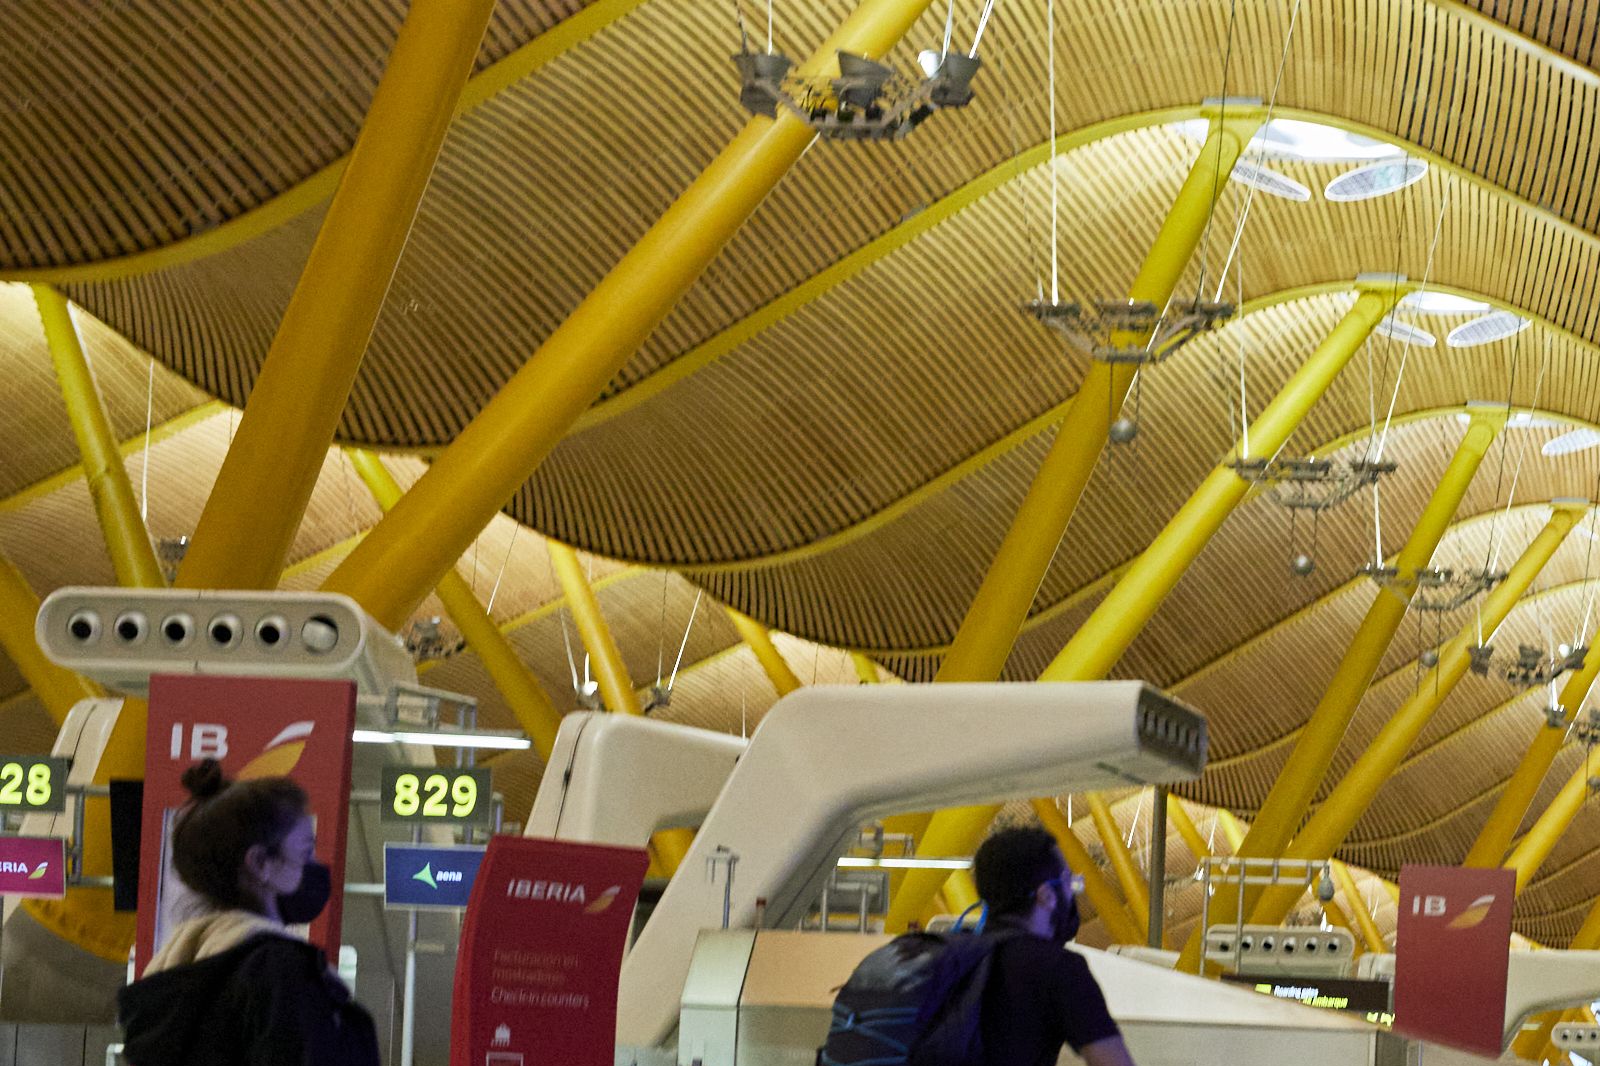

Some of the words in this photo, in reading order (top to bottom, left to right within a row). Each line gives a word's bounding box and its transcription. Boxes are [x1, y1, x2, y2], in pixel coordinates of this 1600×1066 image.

[170, 722, 228, 760] IB
[393, 773, 477, 817] 829
[436, 871, 462, 881] aena
[507, 878, 586, 904] IBERIA
[1412, 895, 1447, 917] IB
